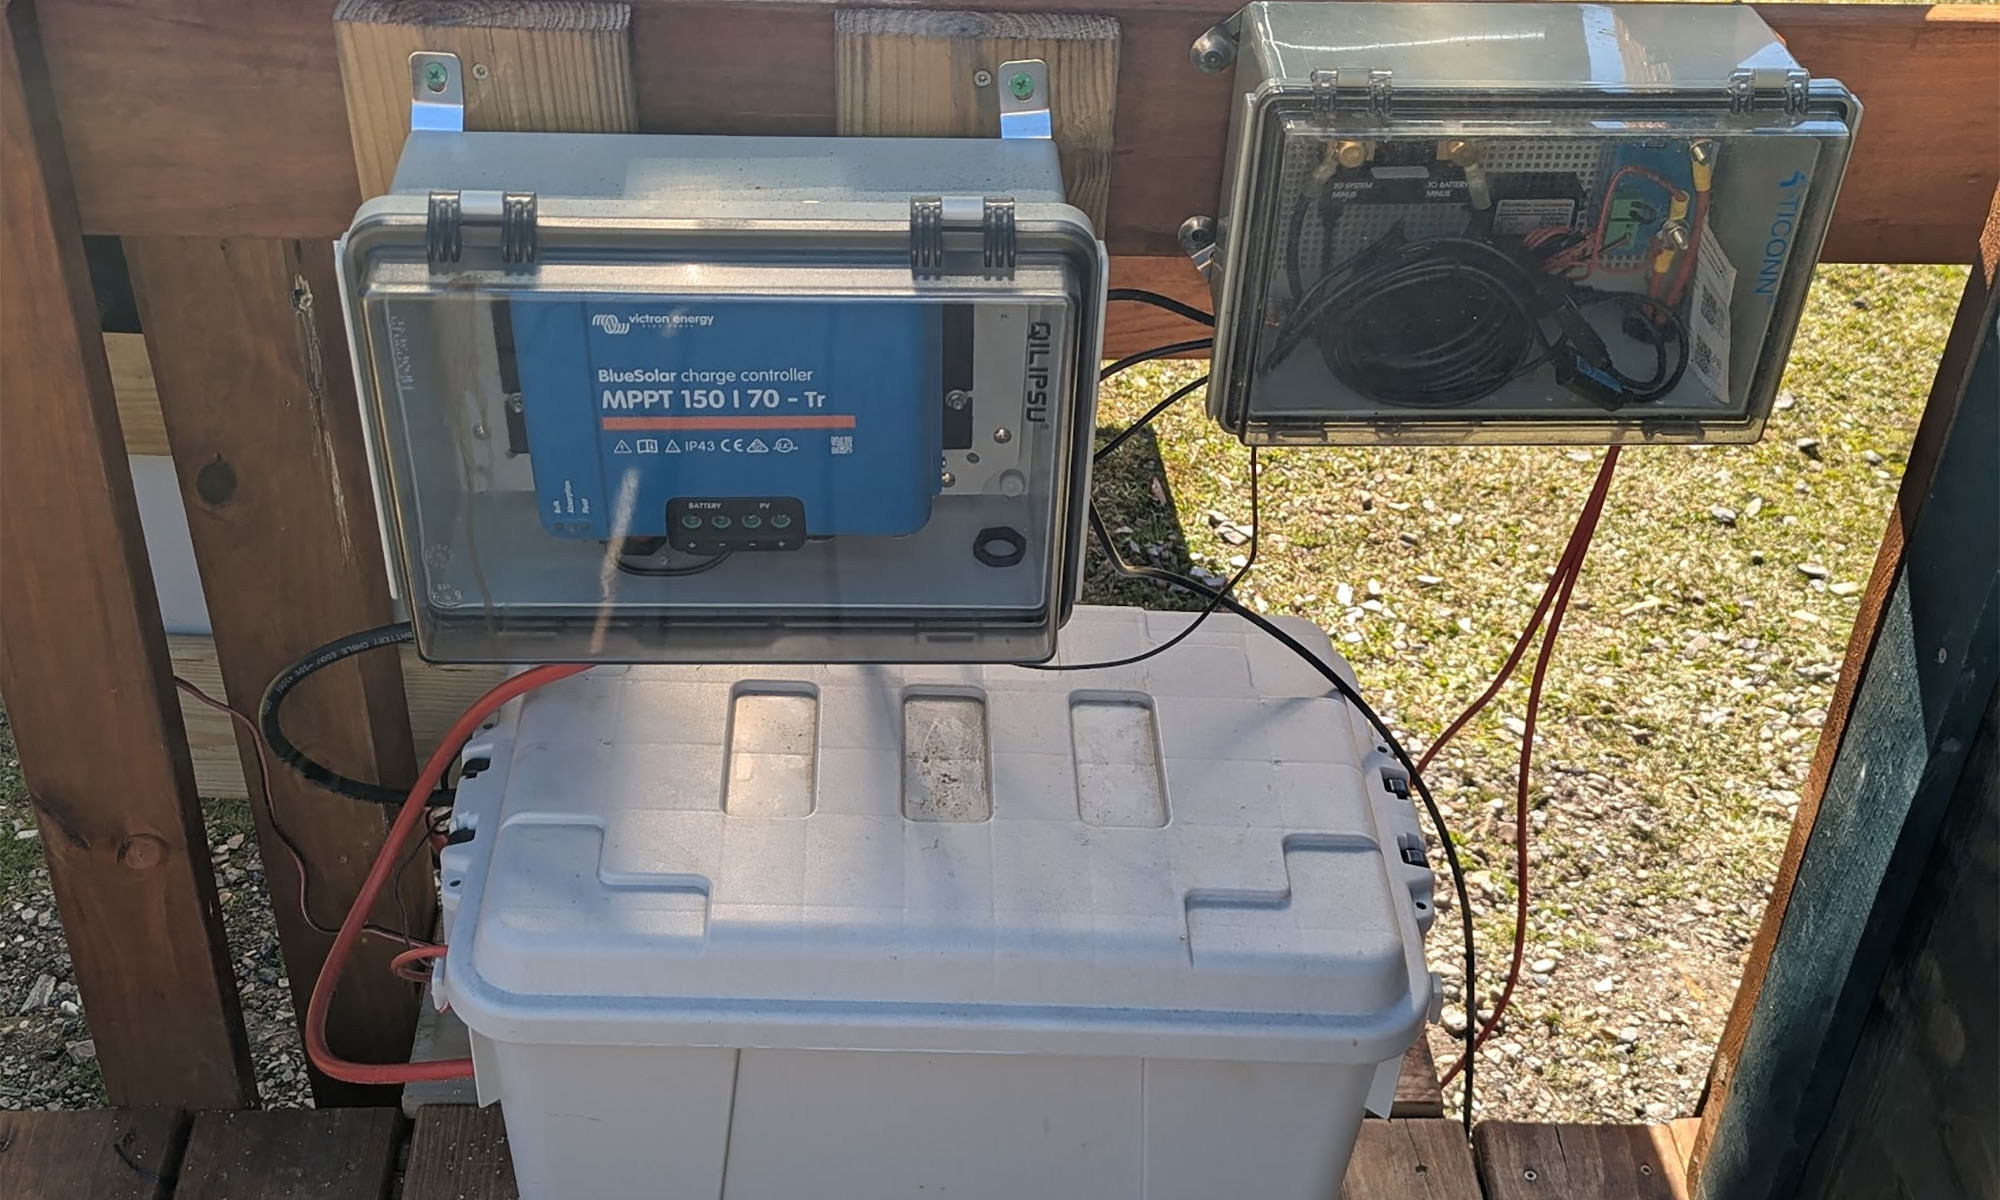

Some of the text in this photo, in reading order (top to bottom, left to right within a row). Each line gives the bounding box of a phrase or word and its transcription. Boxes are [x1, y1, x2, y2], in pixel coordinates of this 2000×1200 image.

[1753, 197, 1800, 294] TICONN
[629, 313, 714, 327] victron energy
[598, 367, 814, 386] BlueSolar charge controller
[1026, 321, 1052, 423] QILIPSU
[602, 389, 674, 409] MPPT
[681, 389, 726, 409] 150
[749, 389, 780, 408] 70
[804, 390, 827, 408] Tr
[685, 440, 716, 452] IP43
[688, 502, 771, 510] BATTERY PV
